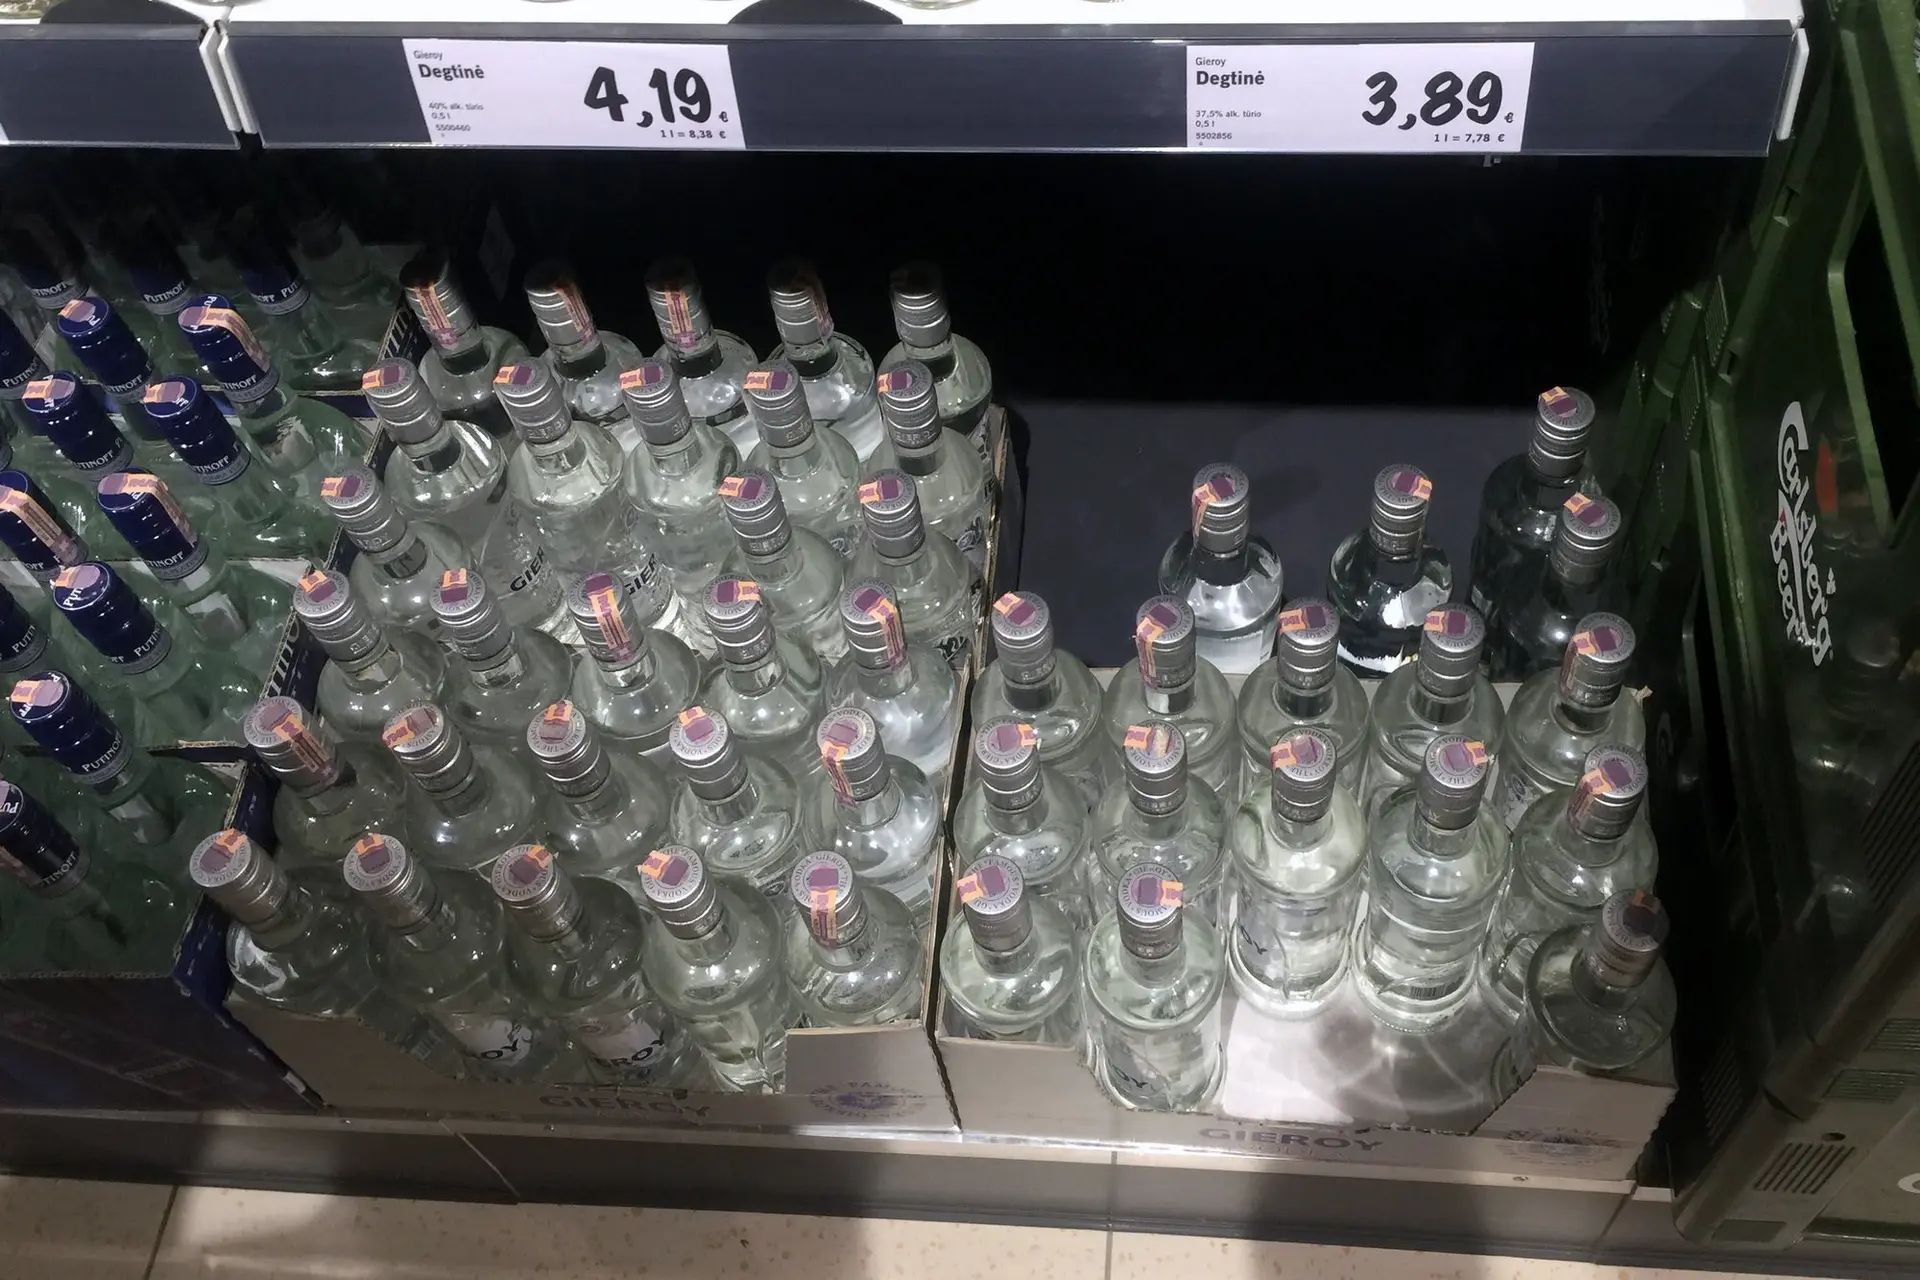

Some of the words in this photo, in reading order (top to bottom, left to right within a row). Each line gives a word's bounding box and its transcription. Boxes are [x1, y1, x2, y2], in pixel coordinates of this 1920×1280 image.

[414, 50, 443, 61] Gieroy
[1195, 56, 1226, 68] Gieroy
[418, 64, 485, 81] Degtinė
[1196, 70, 1265, 89] Degtinė
[584, 66, 712, 128] 4,19
[718, 111, 728, 123] €
[1362, 71, 1503, 130] 3,89
[1504, 112, 1514, 124] €
[428, 102, 447, 111] 40%
[1195, 110, 1223, 119] 37,5%
[1226, 109, 1240, 118] alk.
[1243, 109, 1262, 118] tūrio
[432, 112, 446, 121] 0,5
[1195, 120, 1210, 129] 0,5
[436, 123, 471, 132] 5500460
[689, 130, 713, 140] 8,38
[719, 130, 727, 139] €
[1195, 132, 1233, 140] 5502856
[1465, 133, 1491, 144] 7,78
[1497, 133, 1506, 143] €
[223, 374, 257, 392] TINOFF
[1778, 401, 1833, 667] Carlsberg
[149, 550, 185, 568] TINOFF
[510, 546, 546, 592] GIER
[624, 552, 659, 596] GIER
[1769, 519, 1803, 642] Beer
[81, 729, 122, 773] PUTINOF
[43, 850, 77, 885] TINOFF
[538, 1093, 711, 1119] GIEROY
[1200, 1128, 1384, 1151] GIEROY
